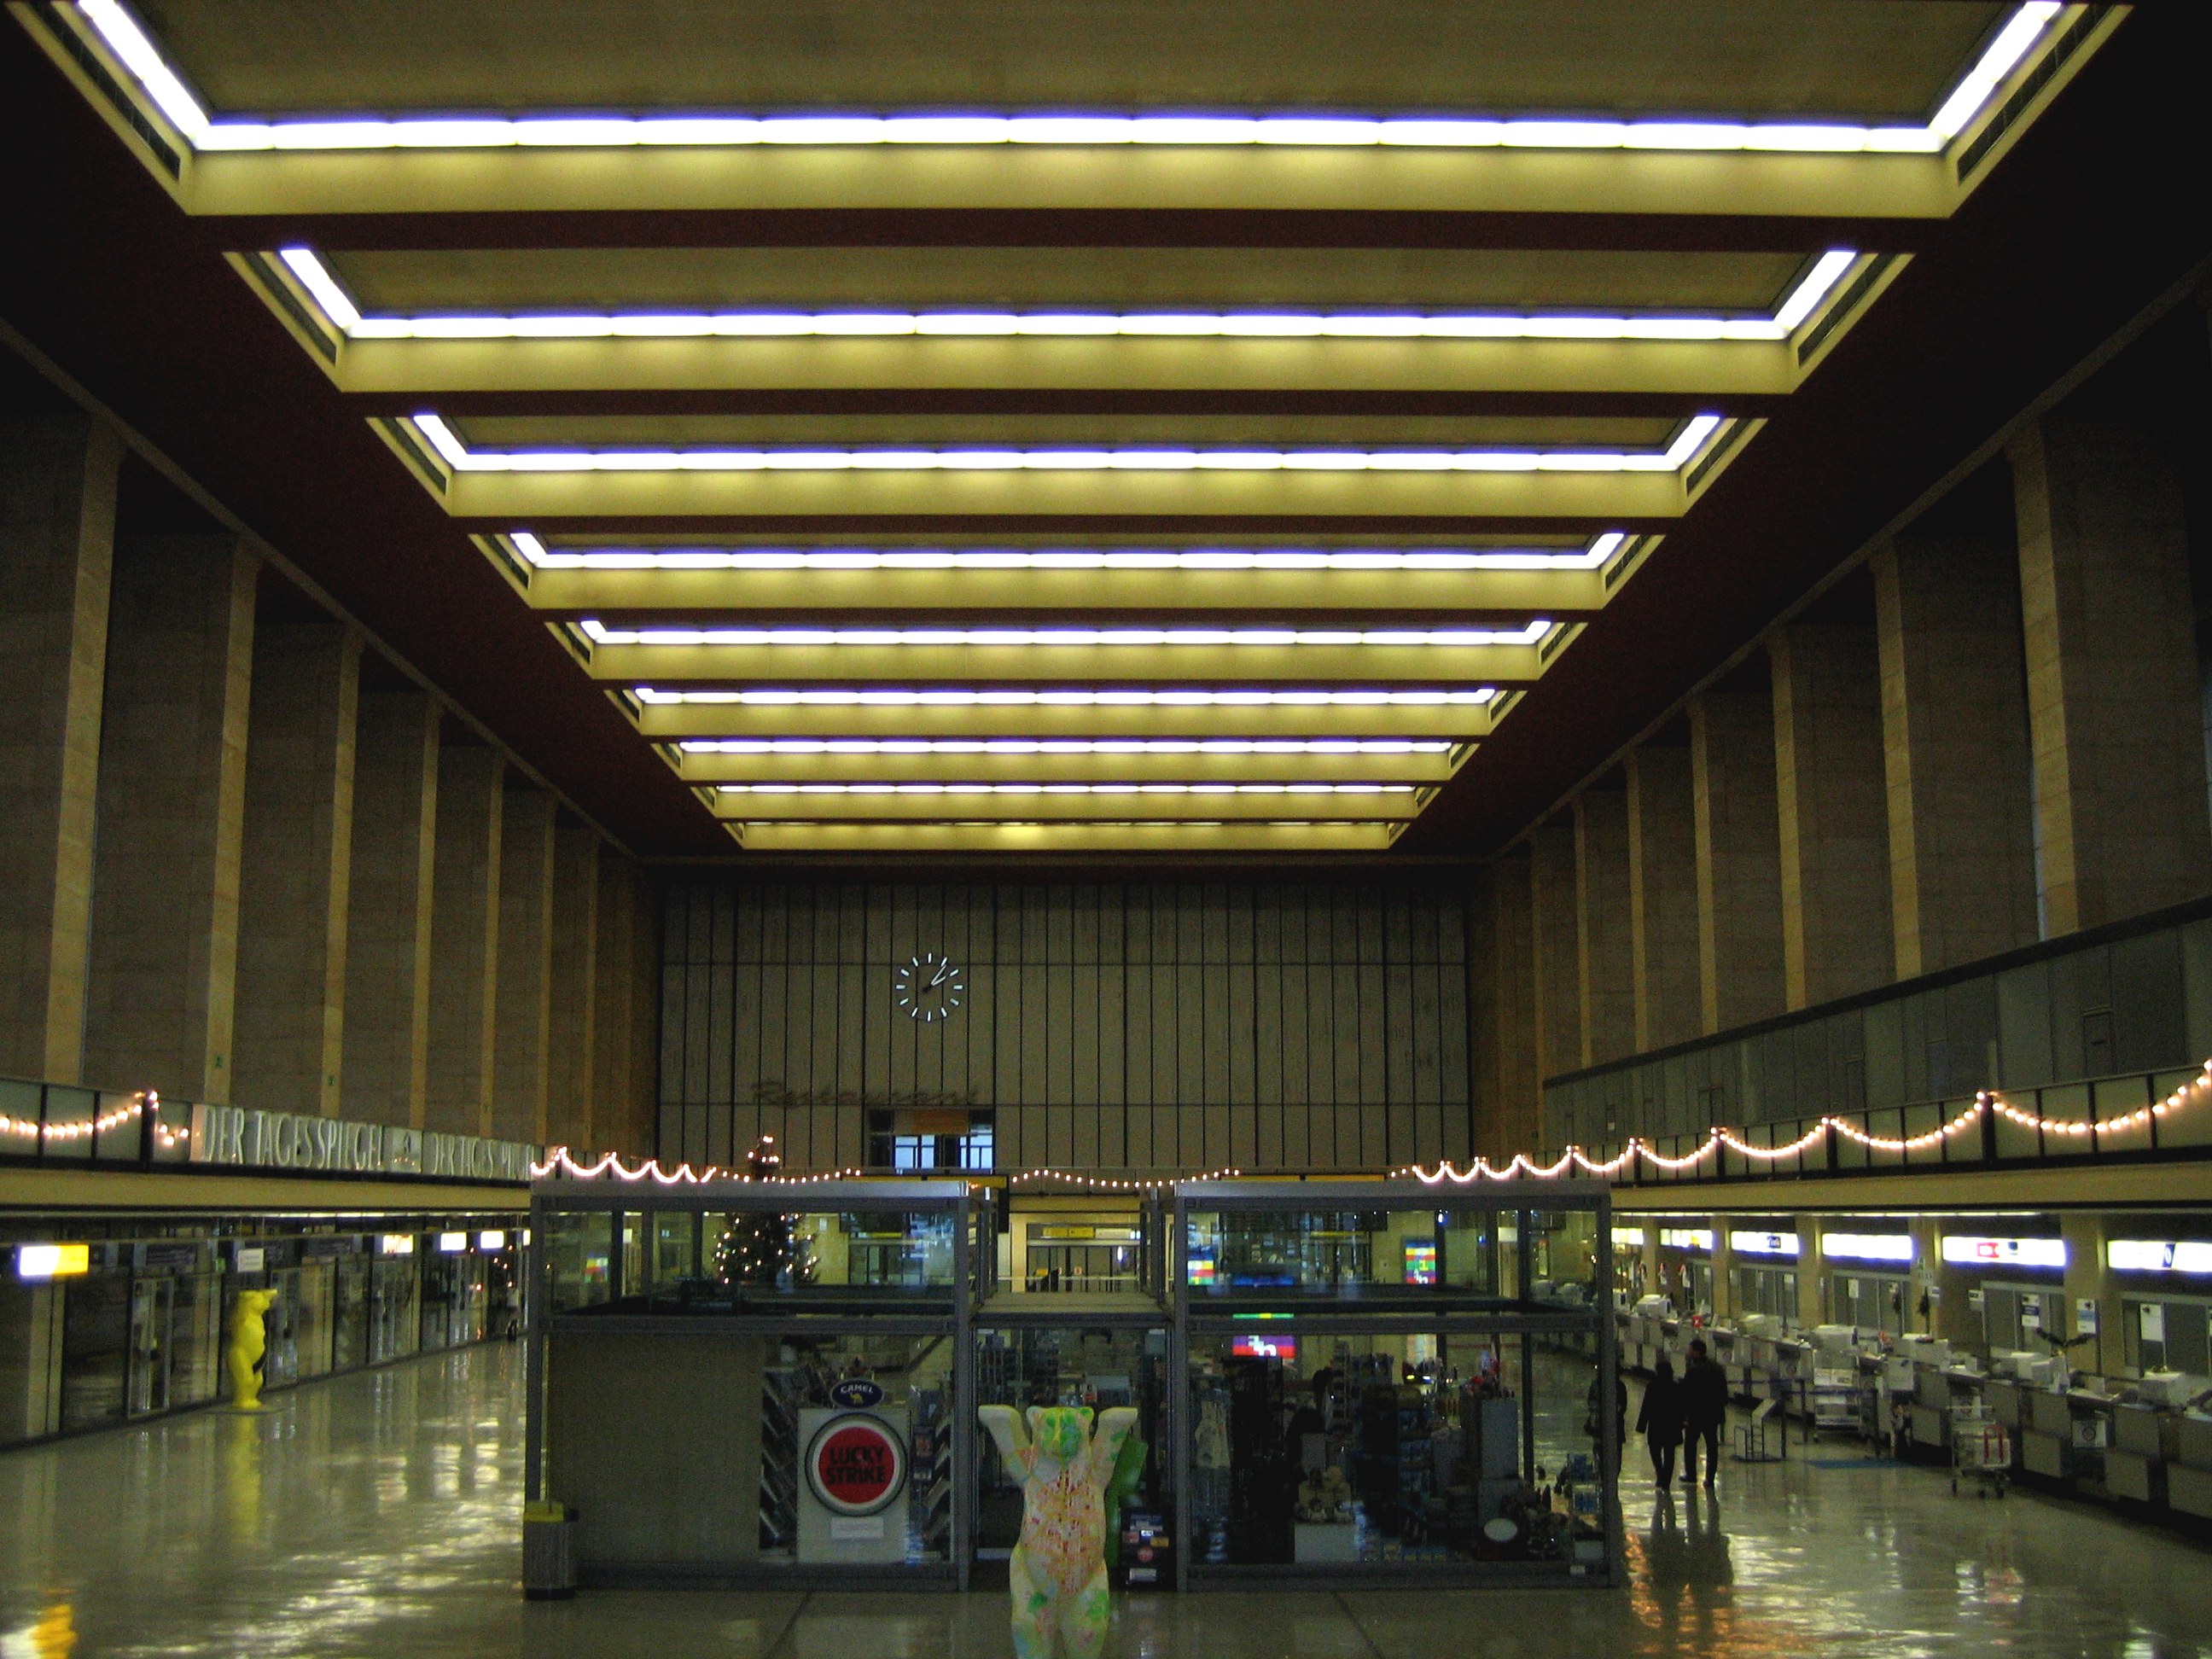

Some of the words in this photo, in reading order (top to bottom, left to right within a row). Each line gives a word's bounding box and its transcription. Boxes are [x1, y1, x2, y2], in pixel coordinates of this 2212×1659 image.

[203, 1106, 245, 1164] DER
[255, 1110, 384, 1171] TAGESSPIEGEL
[841, 1384, 873, 1394] CAMEL
[830, 1446, 883, 1464] LUCKY
[826, 1466, 885, 1483] STRIKE
